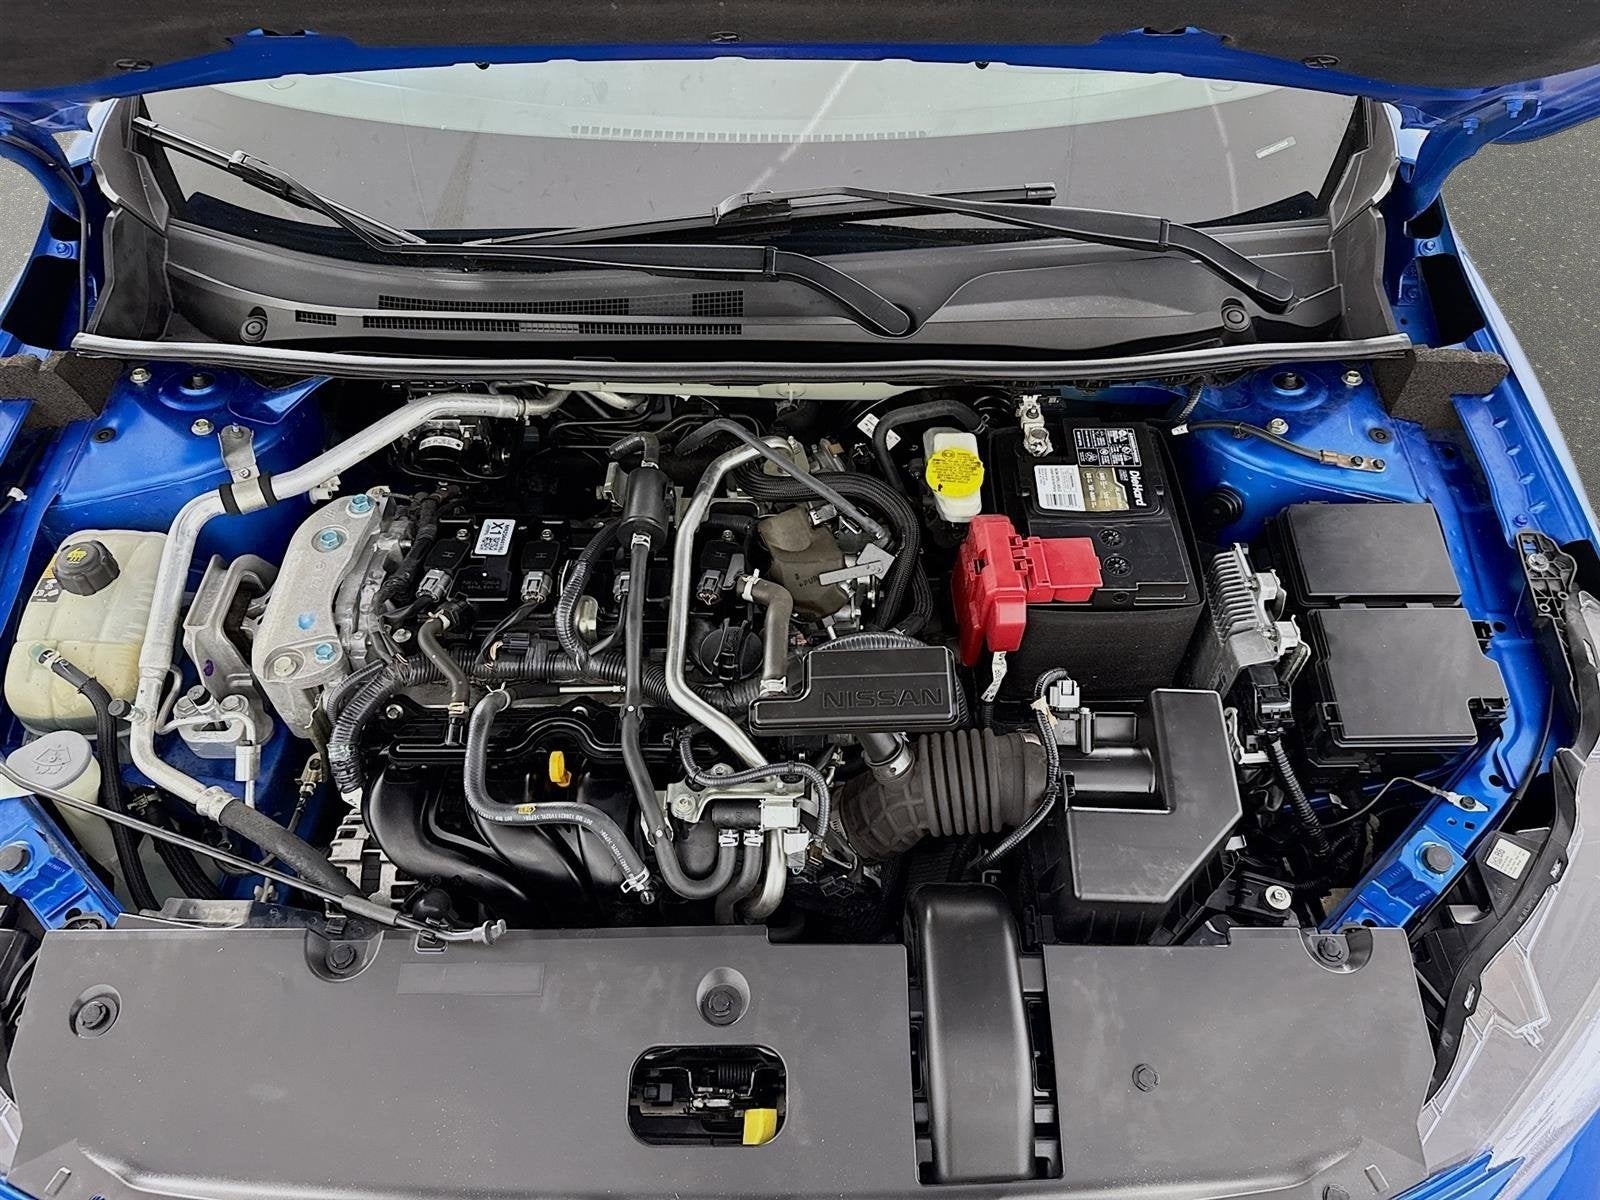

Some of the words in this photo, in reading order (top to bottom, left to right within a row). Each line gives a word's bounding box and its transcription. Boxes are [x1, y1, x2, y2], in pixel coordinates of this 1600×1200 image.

[1129, 470, 1147, 507] DieHard
[489, 522, 505, 535] X1
[822, 688, 943, 709] NISSAN
